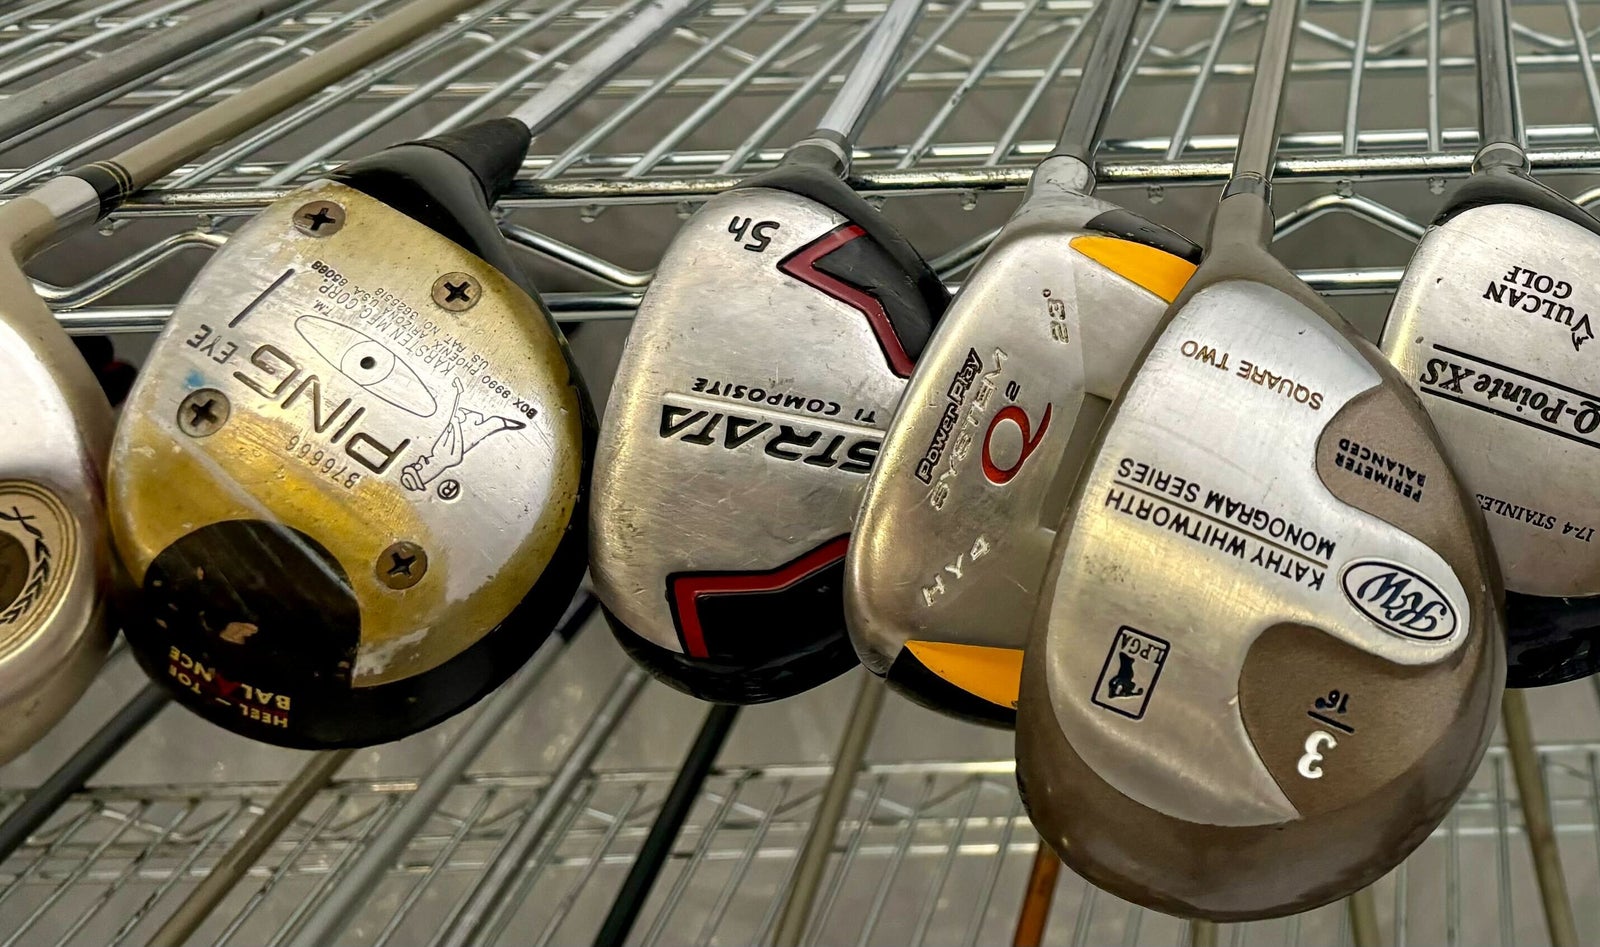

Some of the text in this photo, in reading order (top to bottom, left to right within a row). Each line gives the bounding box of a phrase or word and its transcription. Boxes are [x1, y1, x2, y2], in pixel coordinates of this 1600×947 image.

[728, 216, 780, 252] 5h
[319, 278, 357, 310] CORP.
[1503, 265, 1573, 299] GOLF
[383, 307, 430, 341] ARIZONA
[1483, 281, 1594, 341] VULCAN
[389, 329, 451, 375] KARSTEN
[1180, 340, 1324, 410] SQUARE TWO
[186, 324, 411, 474] PING EYE
[481, 375, 512, 399] 9990
[513, 397, 538, 420] BOX
[691, 377, 876, 424] TI COMPOSITE
[659, 404, 881, 475] STRATA
[930, 347, 1008, 511] SYSTEM
[1335, 452, 1423, 503] PERIMETER
[1339, 438, 1427, 488] BALANCED
[1117, 457, 1336, 560] MONOGRAM SERIES
[1476, 493, 1595, 542] 17-4 STAINLE
[1104, 489, 1325, 591] KATHY WHITWORTH
[1121, 633, 1164, 664] LPGA
[169, 664, 202, 694] TOE
[240, 703, 288, 728] HEEL
[1297, 730, 1338, 779] 3
